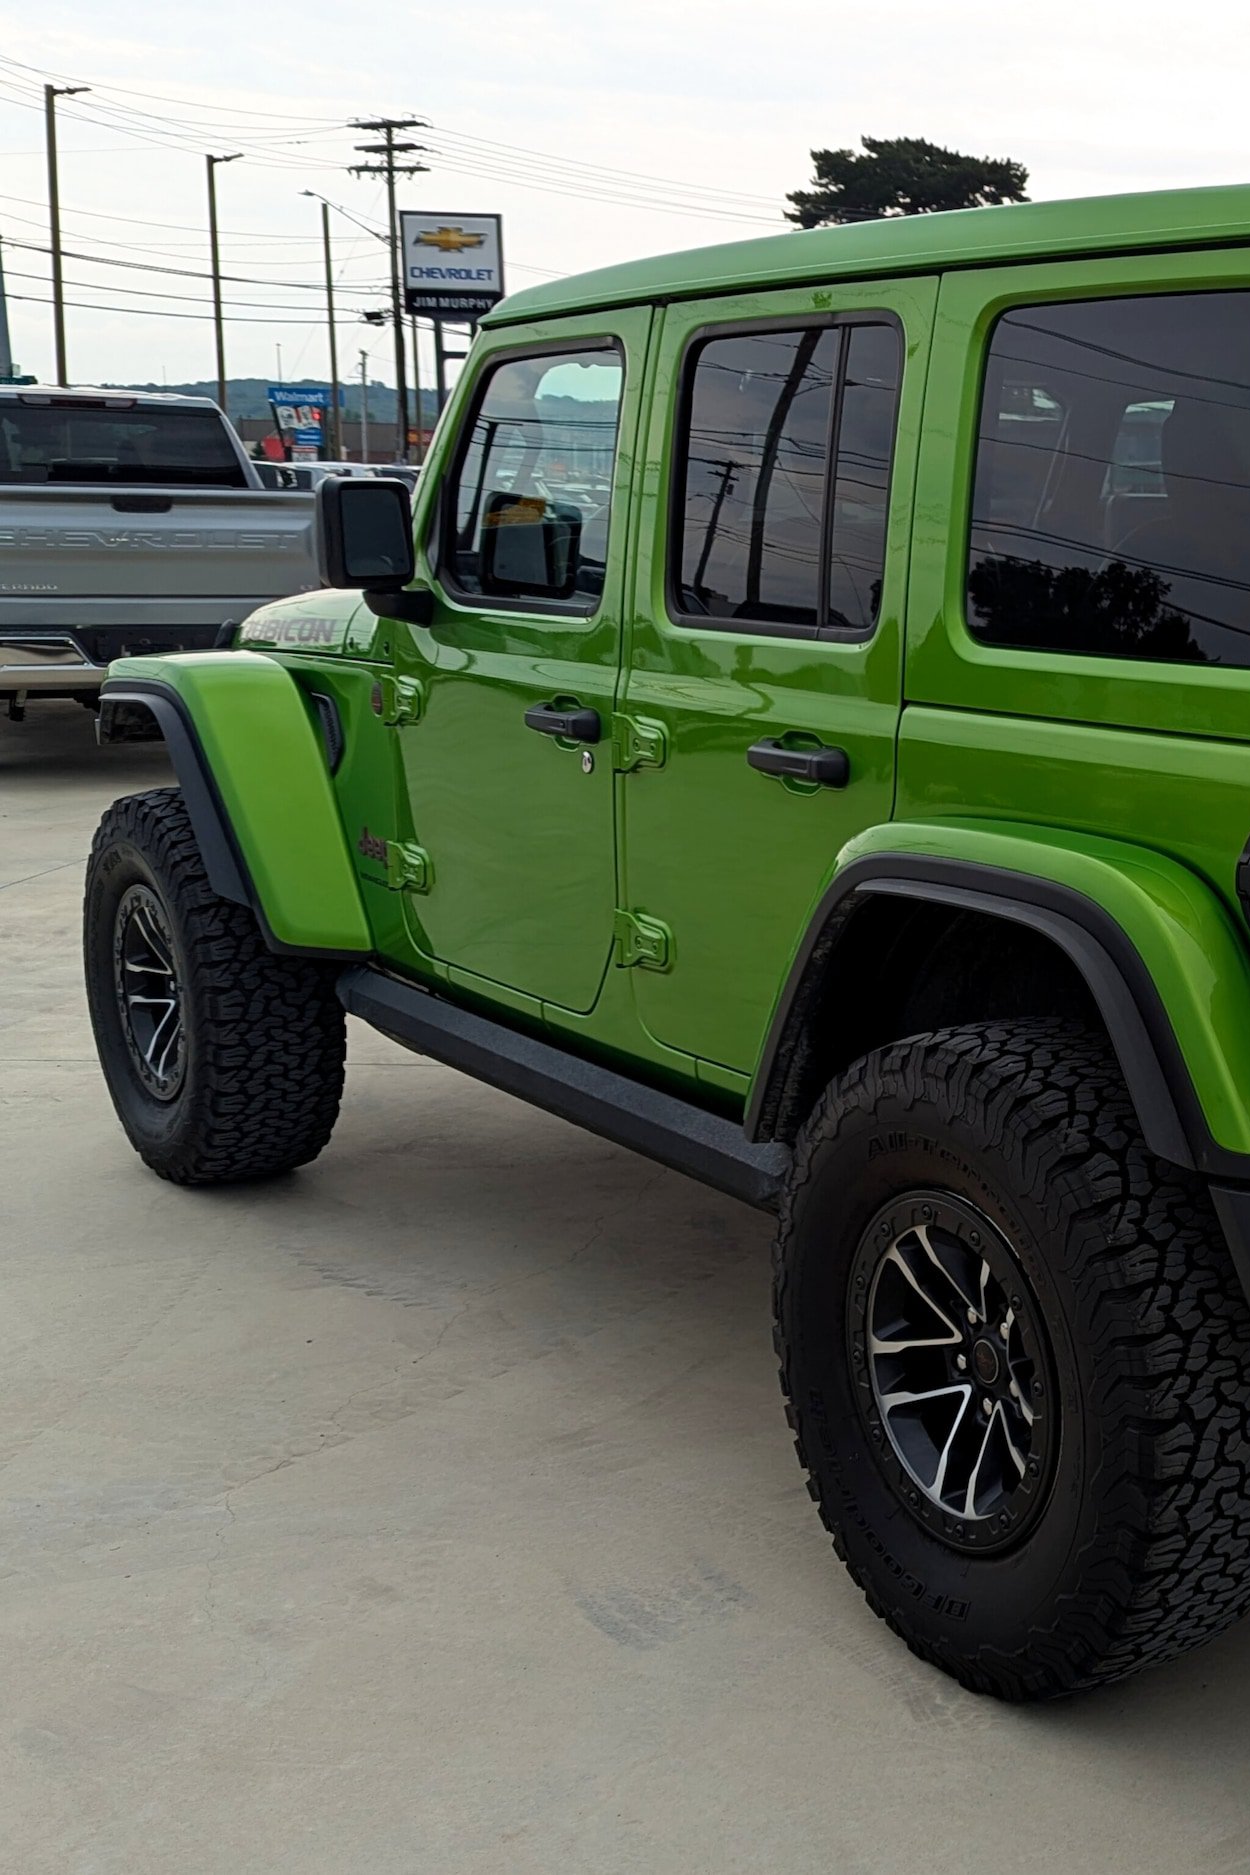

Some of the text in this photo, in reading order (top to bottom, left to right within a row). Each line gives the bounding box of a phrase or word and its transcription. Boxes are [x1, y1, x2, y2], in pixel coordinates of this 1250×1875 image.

[409, 266, 493, 281] CHEVROLET
[412, 296, 494, 310] JIM MURPHY
[273, 391, 324, 403] Walmart
[245, 618, 338, 643] RUBICON
